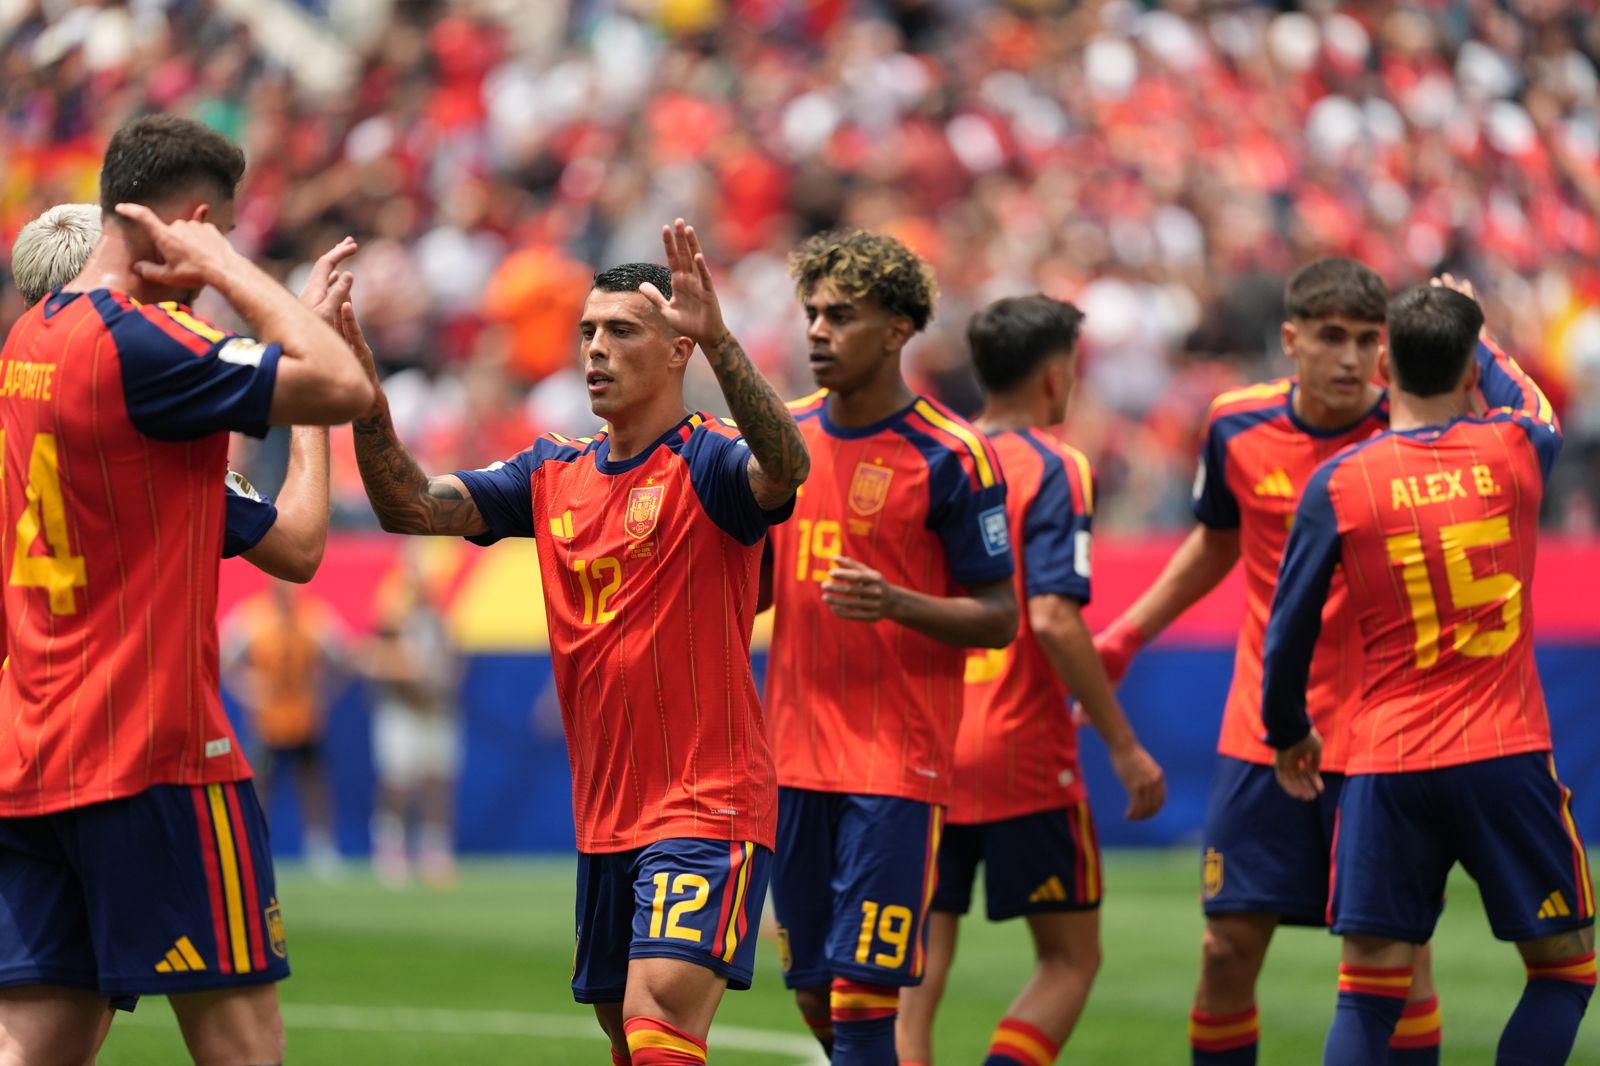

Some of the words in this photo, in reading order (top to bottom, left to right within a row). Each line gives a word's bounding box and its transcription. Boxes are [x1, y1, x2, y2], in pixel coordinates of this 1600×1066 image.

[1391, 469, 1467, 510] ALEX
[1471, 464, 1500, 496] B.
[797, 519, 842, 584] 19
[573, 557, 622, 625] 12
[1386, 516, 1521, 669] 15
[649, 873, 710, 942] 12
[855, 901, 913, 969] 19
